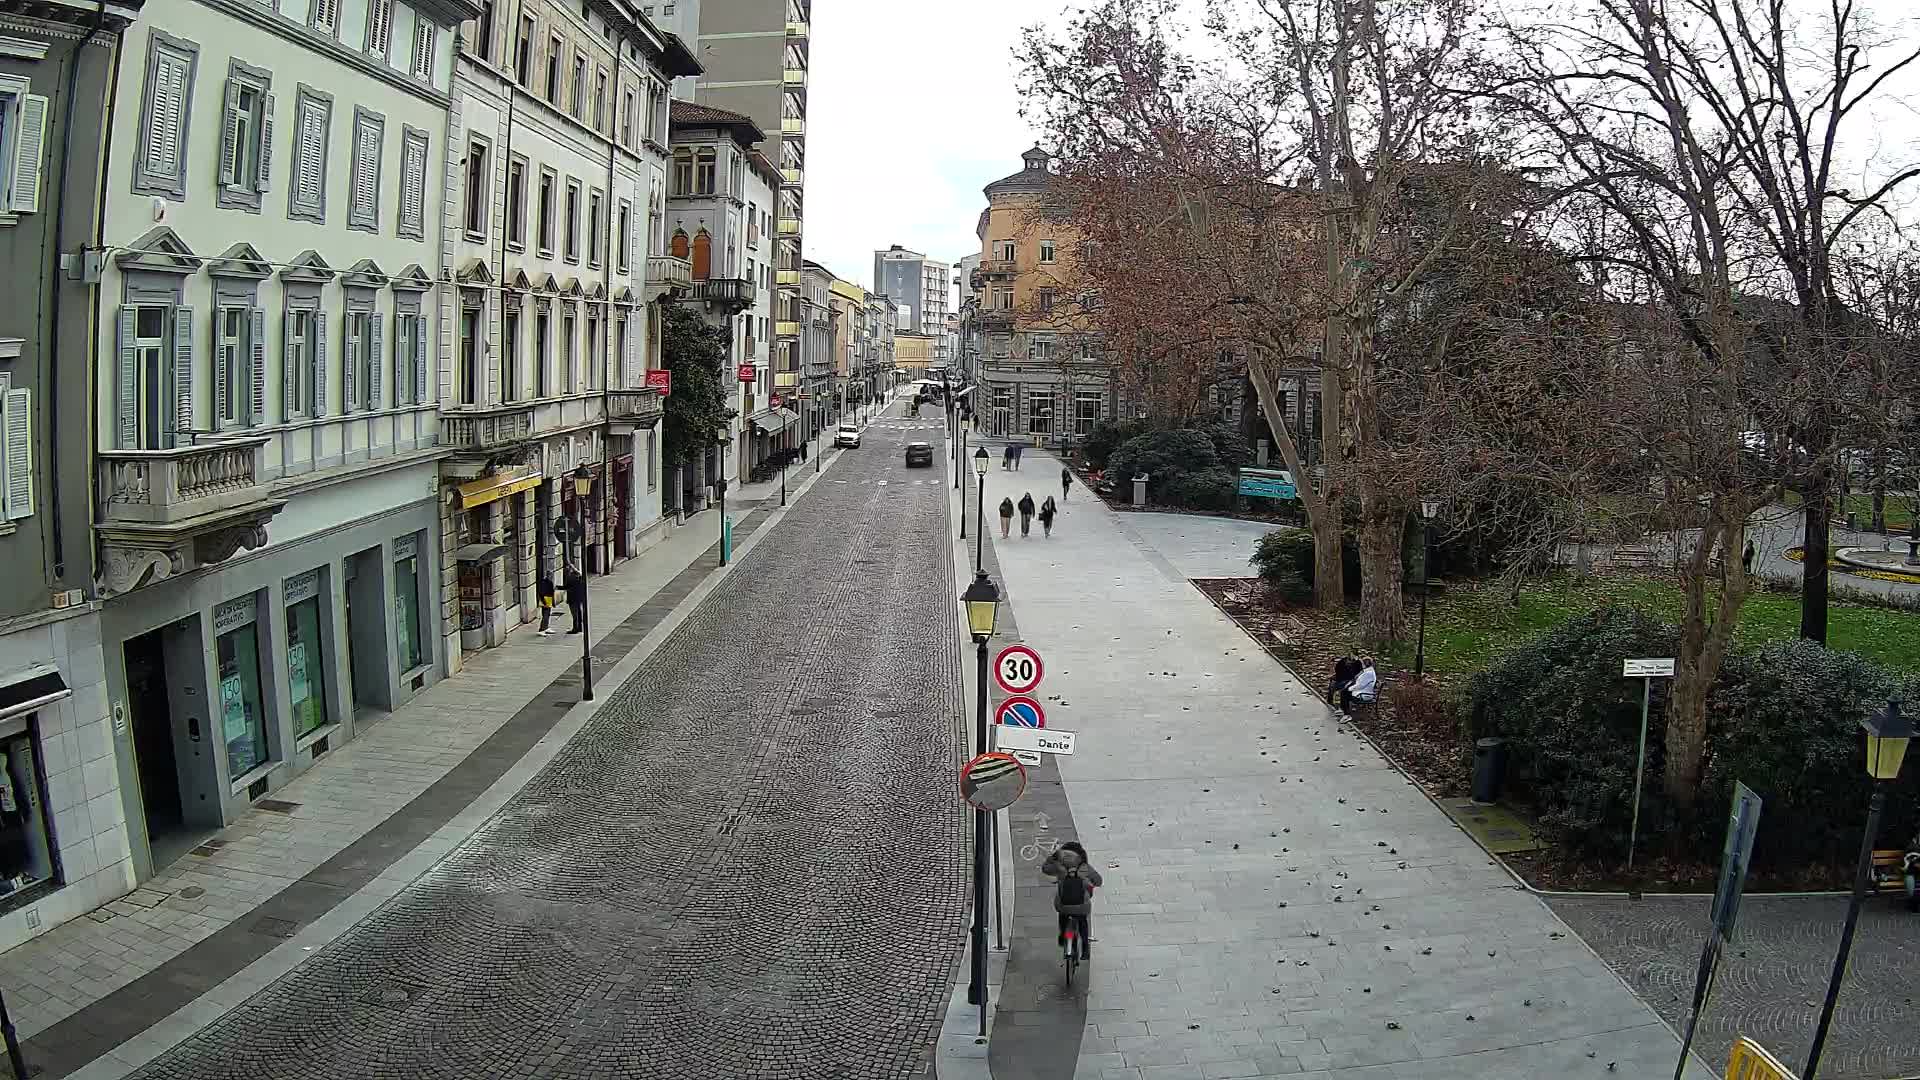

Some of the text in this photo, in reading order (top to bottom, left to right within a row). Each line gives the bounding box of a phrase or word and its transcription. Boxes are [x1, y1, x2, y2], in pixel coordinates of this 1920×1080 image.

[1005, 659, 1033, 681] 30
[222, 678, 240, 701] 130
[1038, 738, 1070, 750] Dante
